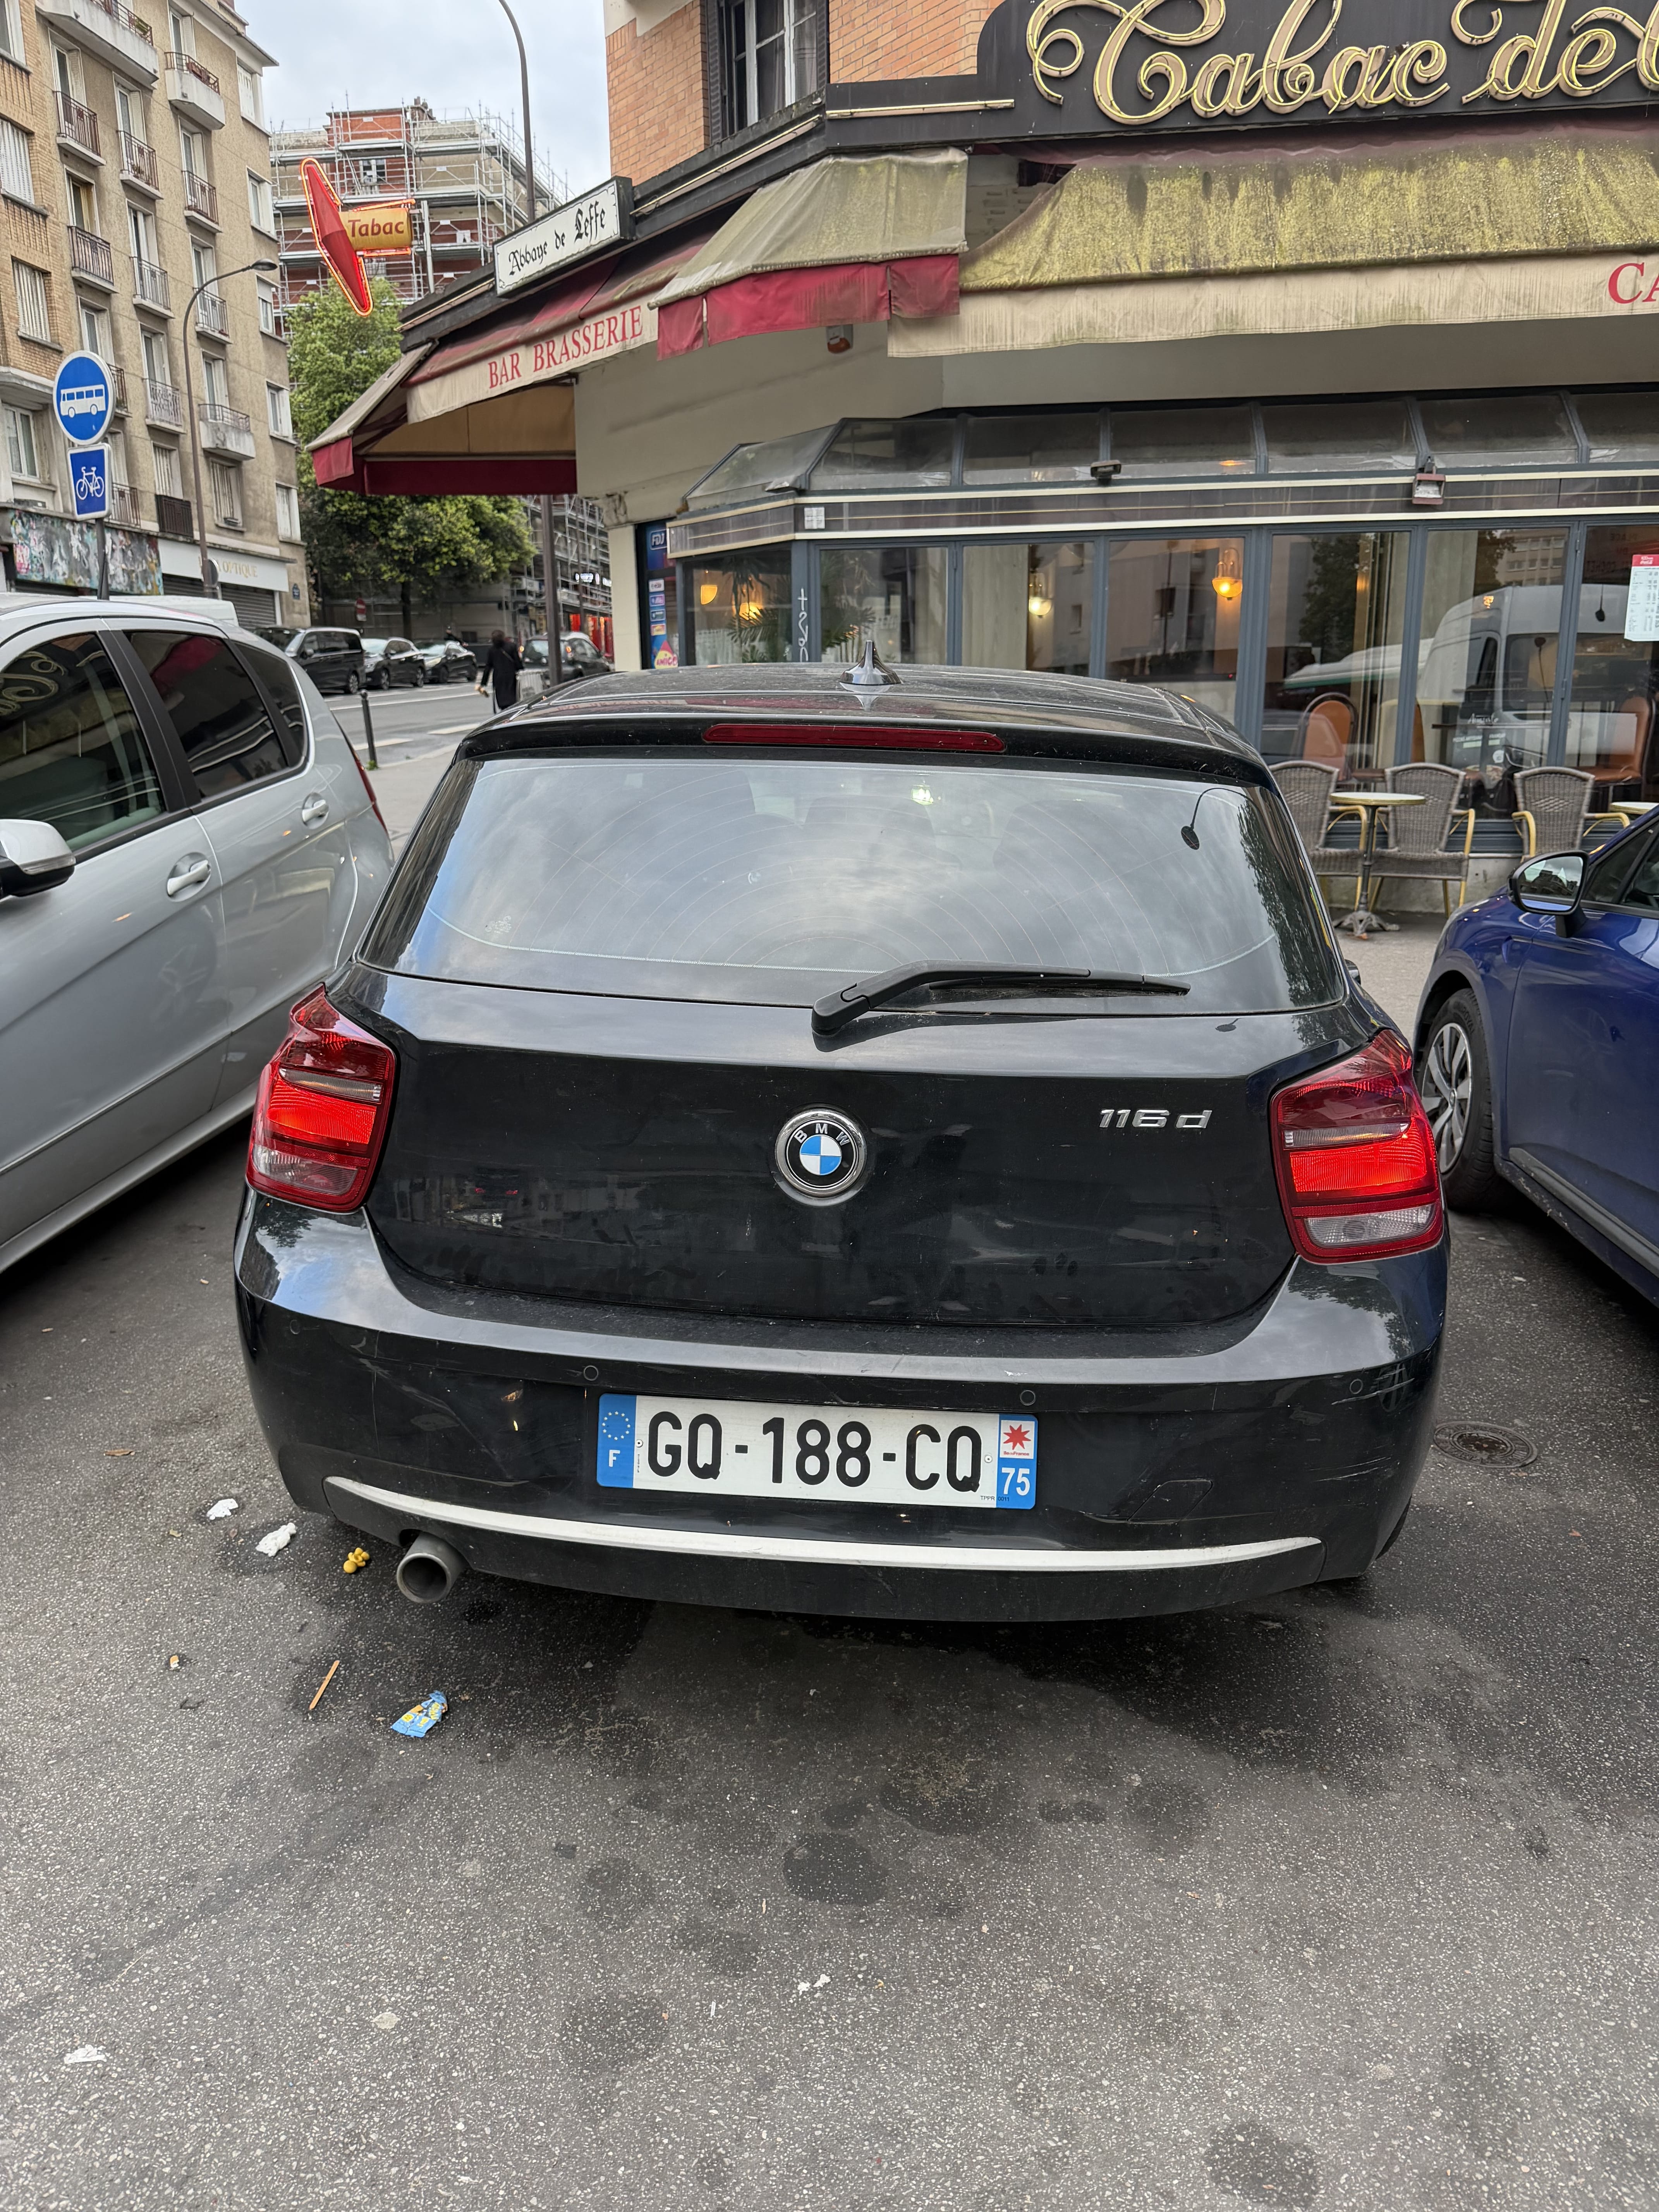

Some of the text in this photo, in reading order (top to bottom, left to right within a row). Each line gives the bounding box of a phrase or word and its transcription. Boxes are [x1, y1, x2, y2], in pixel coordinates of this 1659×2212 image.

[348, 218, 404, 238] Tabac
[508, 200, 606, 276] Abbaye de Leffe
[488, 305, 643, 389] BAR BRASSERIE
[652, 532, 665, 546] FDJ
[222, 561, 258, 578] OPTIQUE
[1099, 1109, 1170, 1128] 116
[794, 1123, 850, 1146] BMW
[609, 1449, 620, 1467] F
[648, 1411, 982, 1493] GQ-188-CQ
[1001, 1467, 1030, 1496] 75
